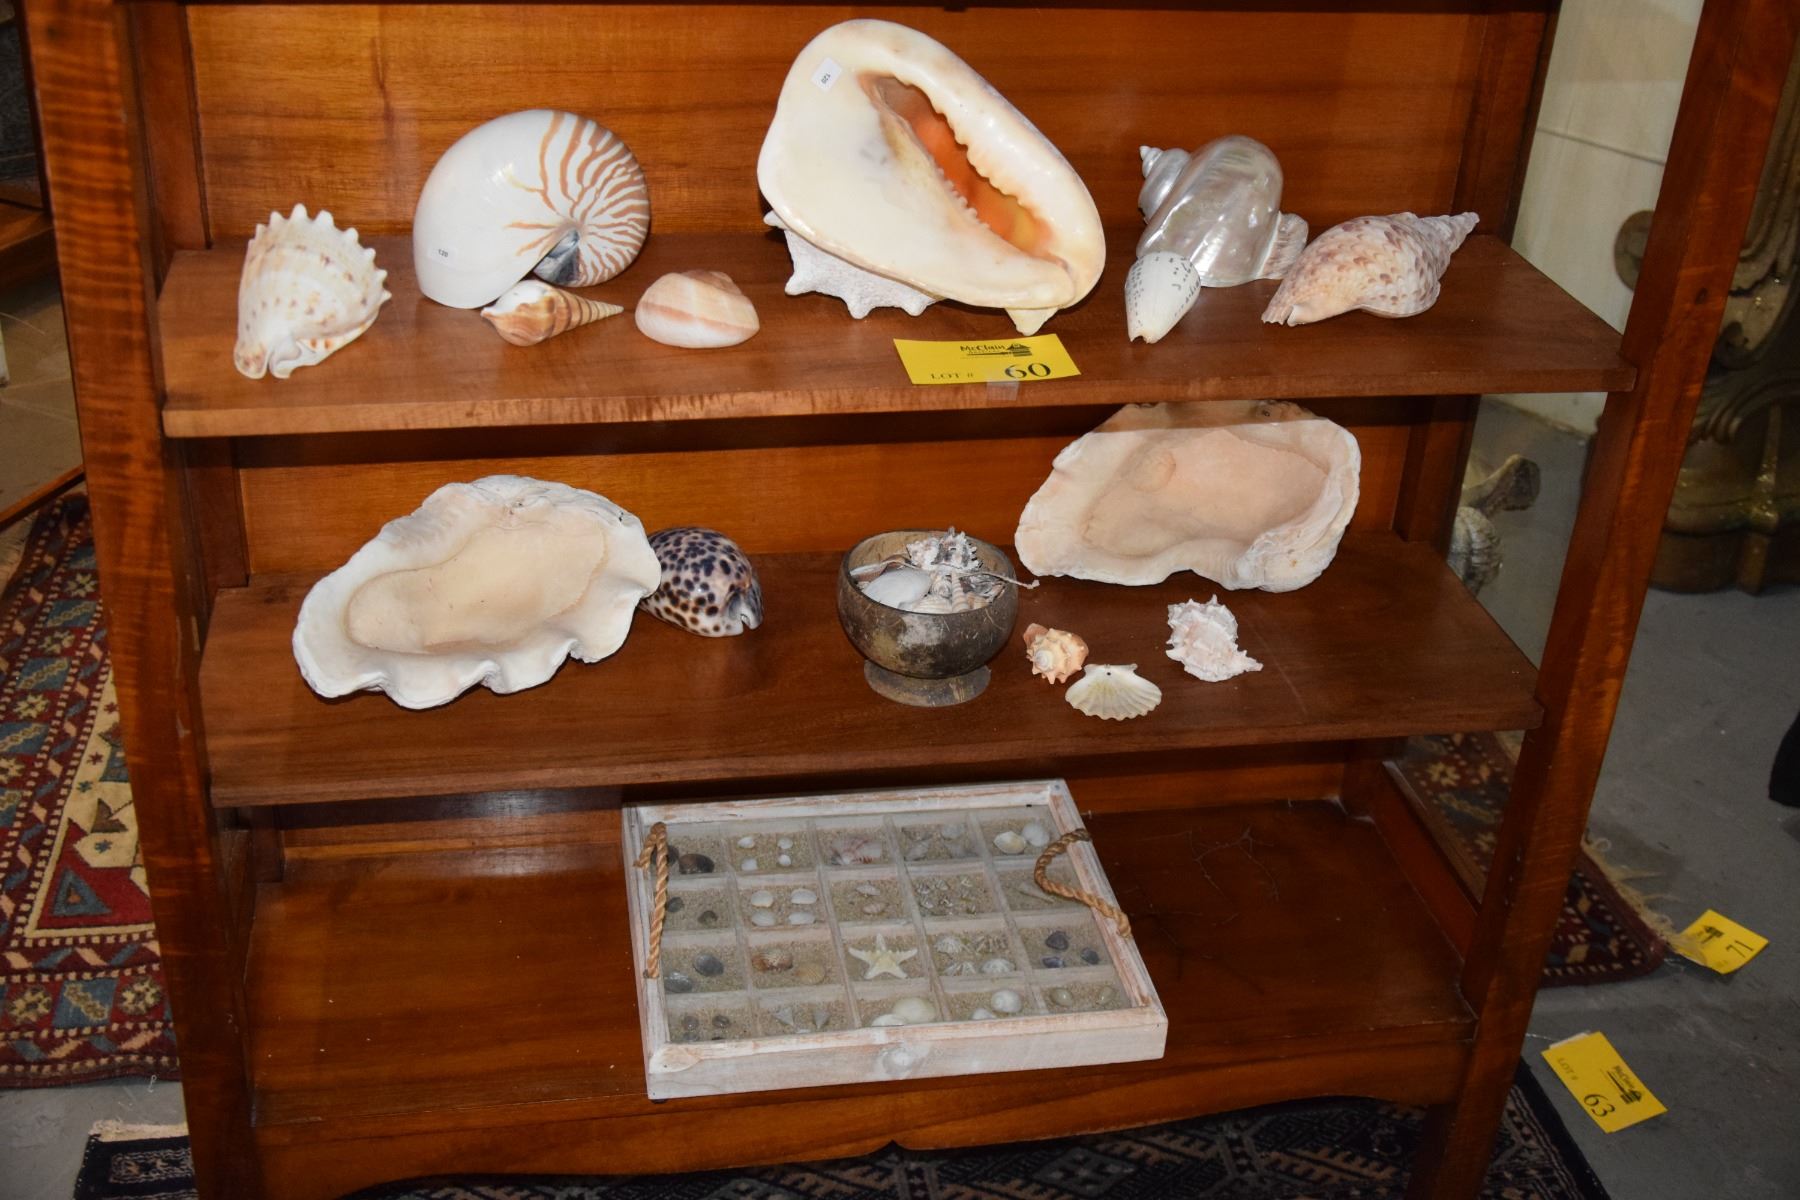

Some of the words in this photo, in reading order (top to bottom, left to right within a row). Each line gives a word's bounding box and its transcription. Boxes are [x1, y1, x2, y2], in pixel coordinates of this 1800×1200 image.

[1004, 362, 1052, 379] 60
[1725, 939, 1754, 959] 71
[1583, 1093, 1616, 1118] 63
